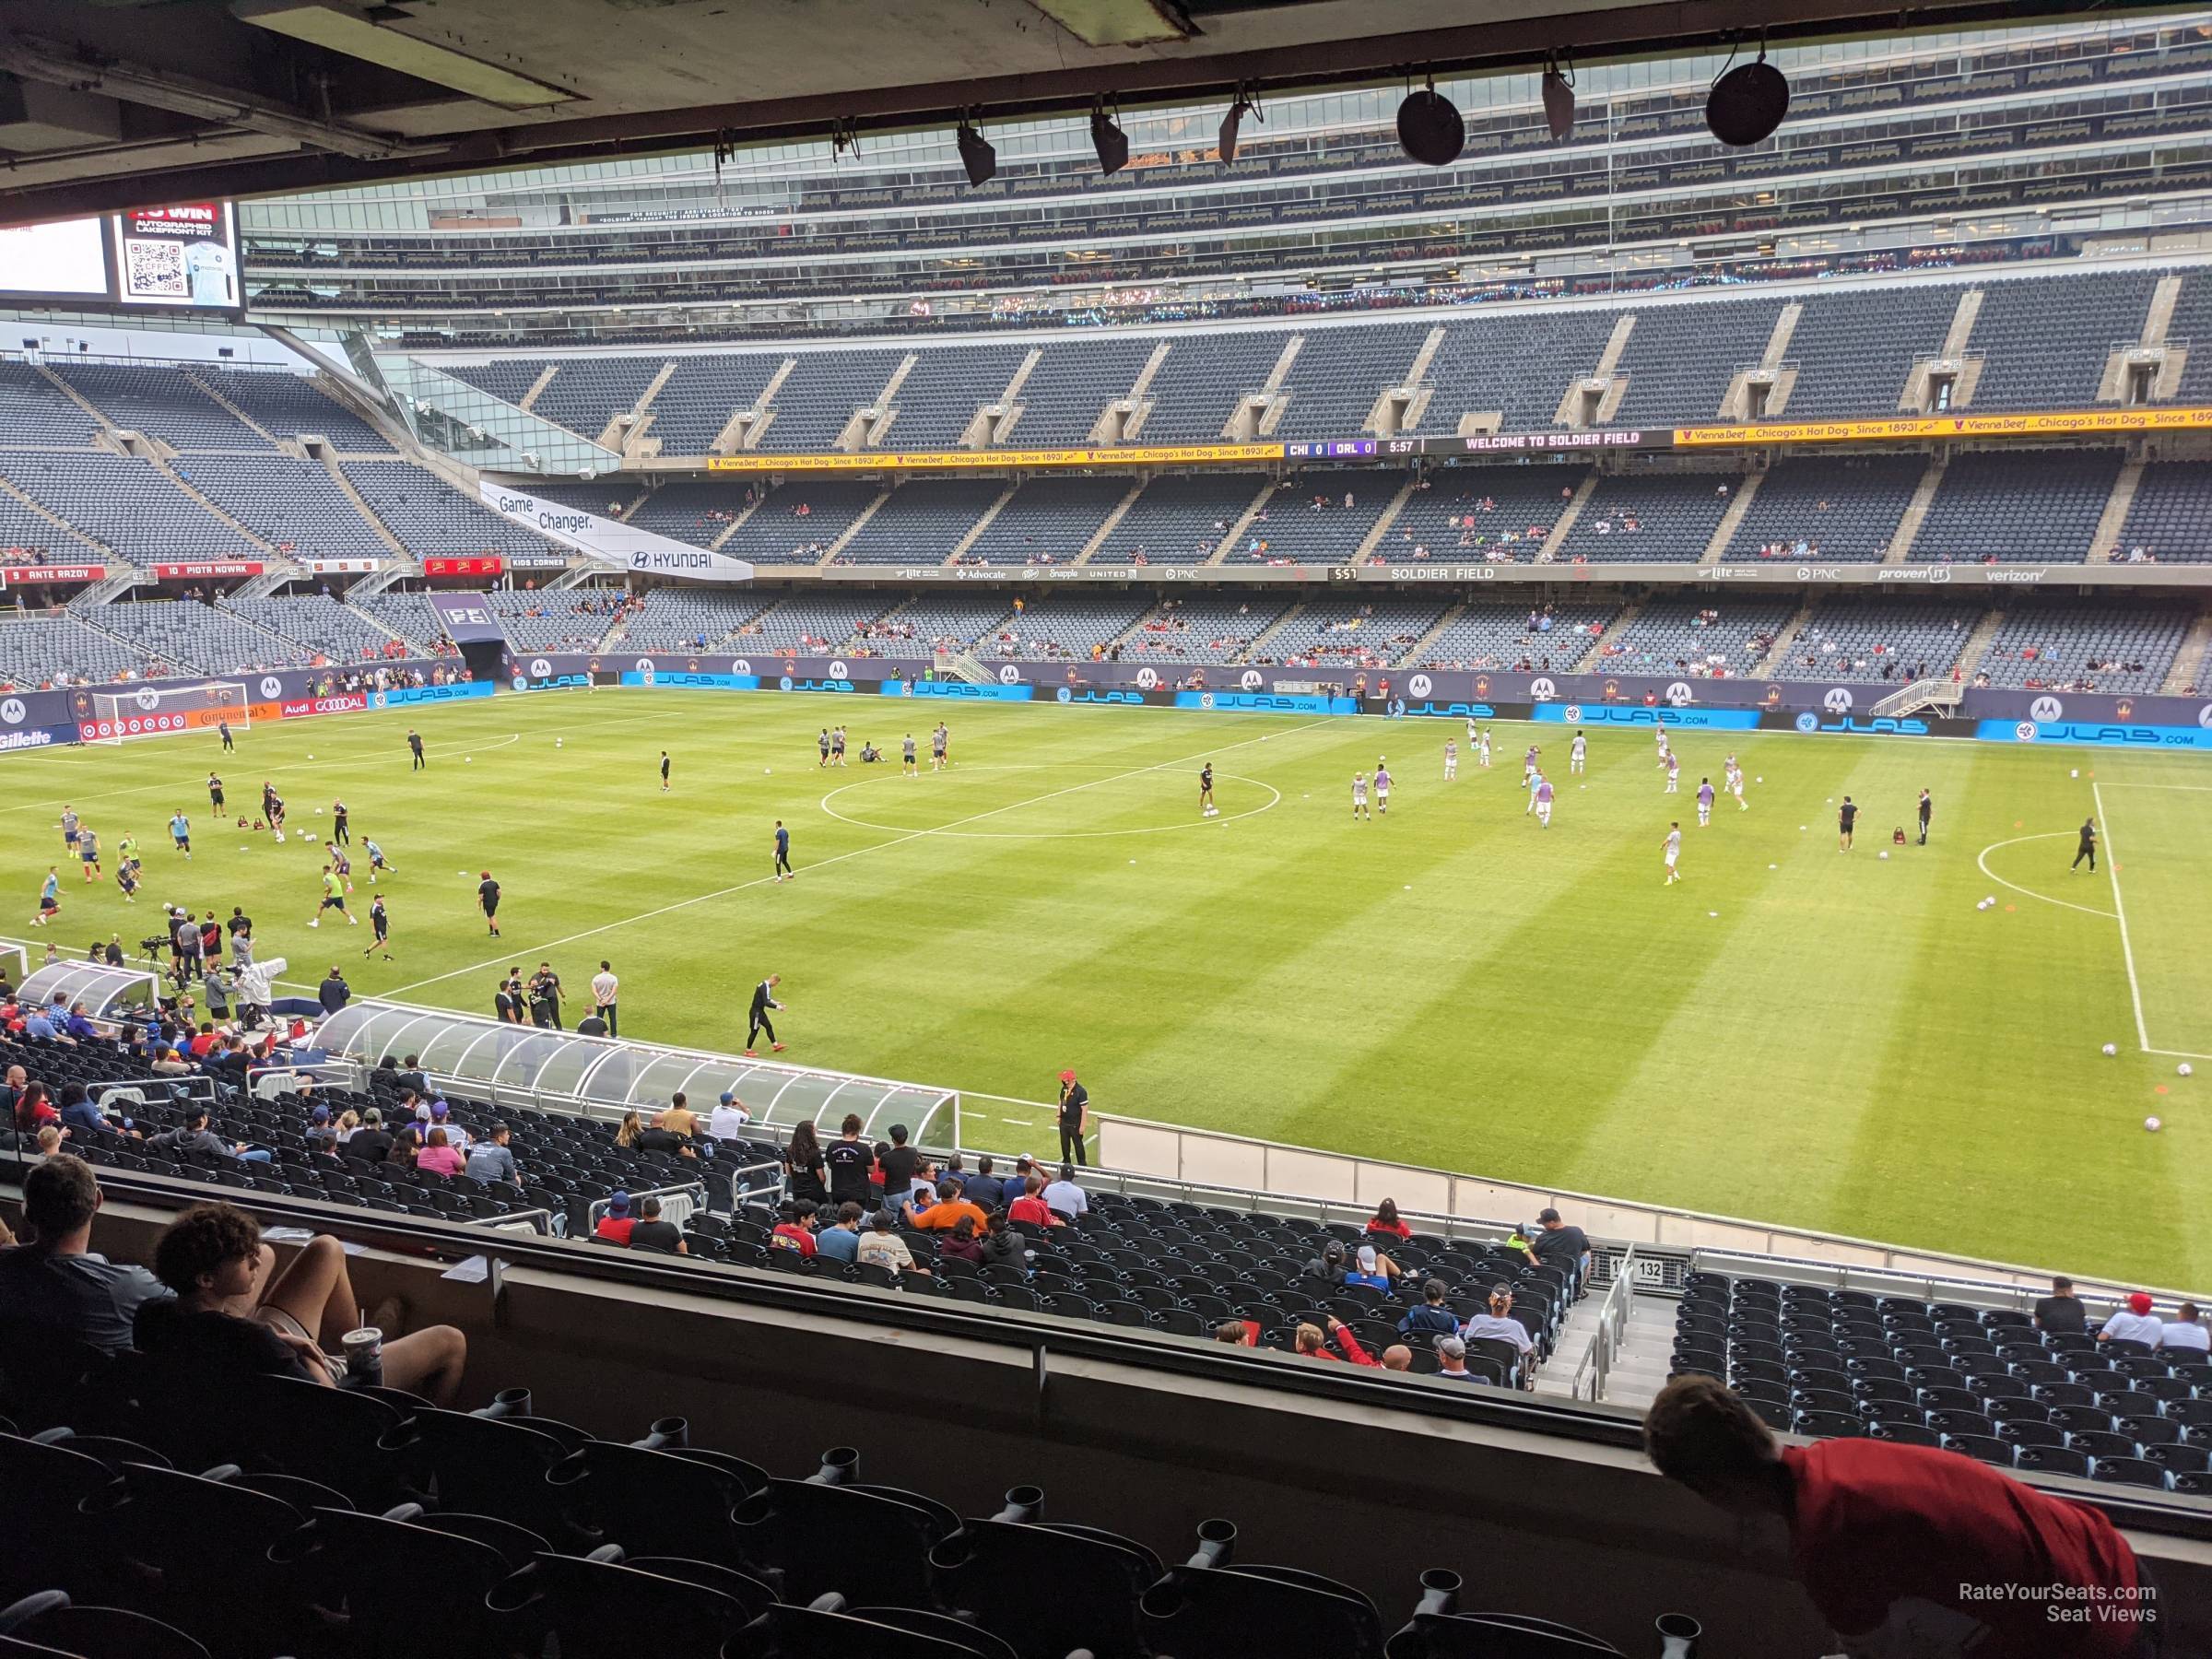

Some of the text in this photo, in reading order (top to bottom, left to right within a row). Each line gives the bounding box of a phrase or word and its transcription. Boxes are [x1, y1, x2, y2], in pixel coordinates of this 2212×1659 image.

[168, 208, 213, 220] WIN
[135, 226, 195, 236] LAKEFRONT
[136, 220, 212, 230] AUTOGRAPHED
[1968, 419, 2004, 429] Vienna
[2096, 415, 2117, 426] Hot
[2154, 413, 2185, 424] Since
[1694, 429, 1724, 441] Vienna
[1806, 426, 1824, 436] Hot
[1856, 424, 1884, 434] Since
[1465, 432, 1640, 450] WELCOME TO SOLDIER FIELD
[1289, 441, 1413, 455] CHI 0 ORL 0 5:57
[986, 454, 999, 463] Hot
[1020, 453, 1041, 462] Since
[1096, 452, 1120, 461] Vienna
[1181, 449, 1194, 458] Hot
[1218, 448, 1239, 457] Since
[800, 458, 812, 466] Hot
[500, 496, 534, 512] Game
[539, 512, 593, 533] Changer.
[653, 553, 712, 569] HYUNDAI
[13, 569, 88, 580] 9 ANTE RAZOV
[187, 566, 212, 574] PIOTR
[215, 565, 247, 573] NOWAK
[906, 569, 922, 579] Lite
[967, 570, 1006, 579] Advocate
[1049, 569, 1078, 580] Snapple
[1177, 569, 1199, 579] PNC
[1335, 569, 1357, 579] 5:57
[1391, 569, 1494, 580] SOLDIER FIELD
[1712, 567, 1733, 580] Lite
[1812, 569, 1841, 580] PNC
[1878, 569, 1945, 580] proven IT
[1986, 569, 2039, 582] verizon
[794, 679, 855, 692] JLAB
[1073, 690, 1144, 704] JLAB
[285, 703, 309, 715] Audi
[1407, 702, 1495, 717] JLAB
[1820, 716, 1928, 735] JLAB
[0, 731, 51, 748] Gillette
[1640, 1262, 1661, 1277] 132
